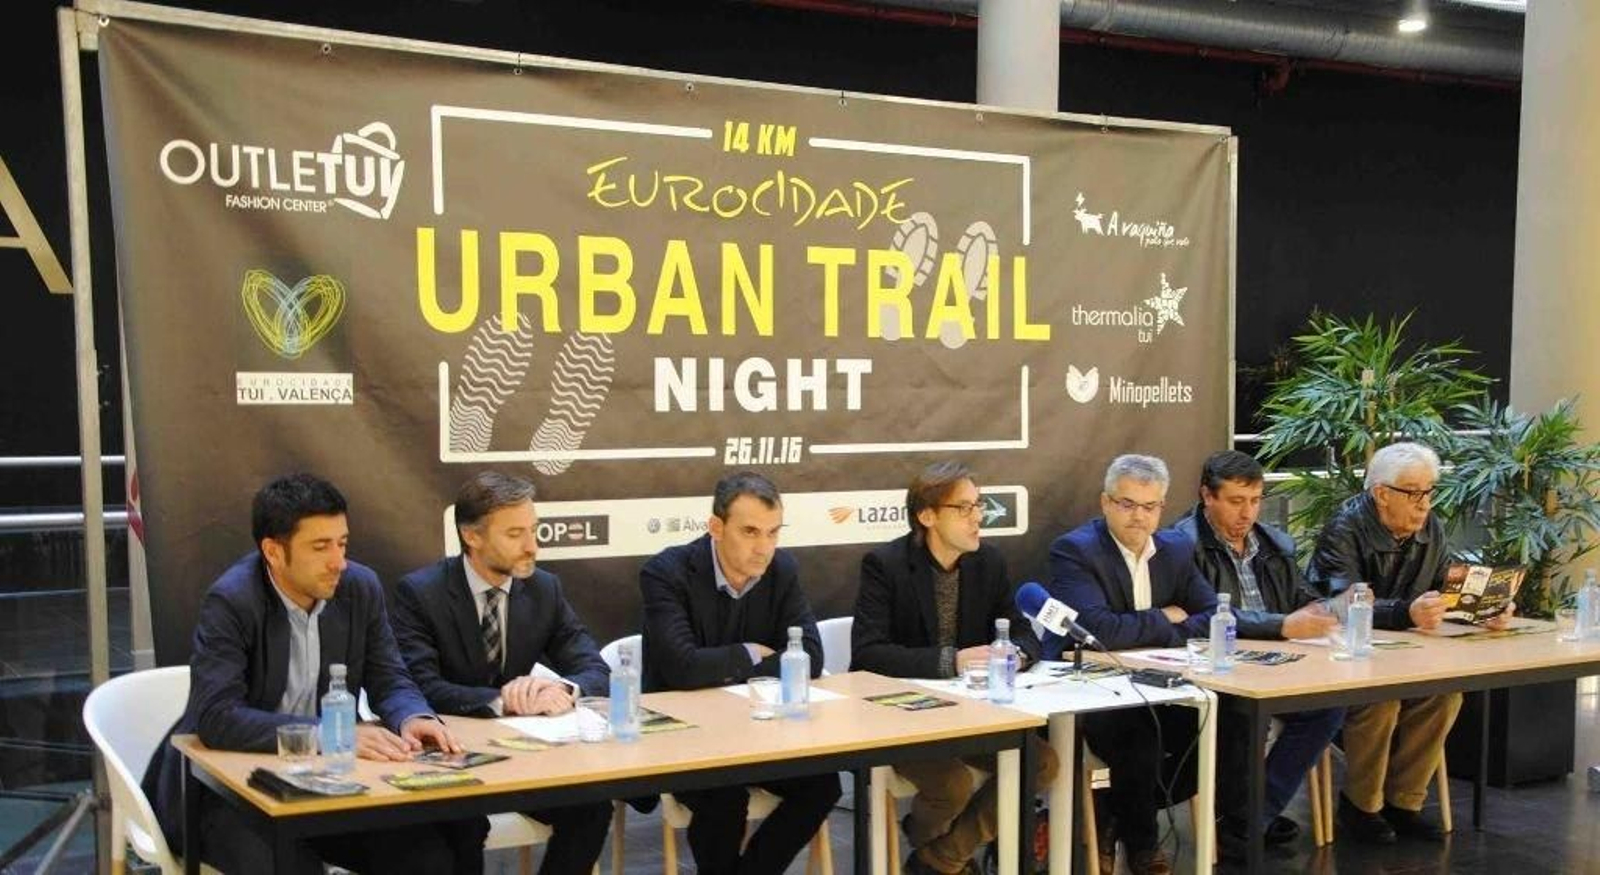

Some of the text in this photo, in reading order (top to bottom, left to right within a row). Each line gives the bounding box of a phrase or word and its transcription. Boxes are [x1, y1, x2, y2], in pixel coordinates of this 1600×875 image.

[722, 120, 797, 157] 14 KM
[225, 194, 281, 211] FASHION
[586, 155, 916, 228] EUROCIDADE
[416, 226, 1052, 341] URBAN TRAIL
[1072, 305, 1154, 326] thermalia
[1138, 330, 1153, 343] tui
[239, 388, 264, 400] TUI
[278, 388, 352, 403] VALENÇA
[653, 356, 873, 413] NIGHT
[1109, 376, 1193, 408] Miñopellets
[724, 437, 803, 465] 26.11.16
[682, 517, 709, 532] Álva
